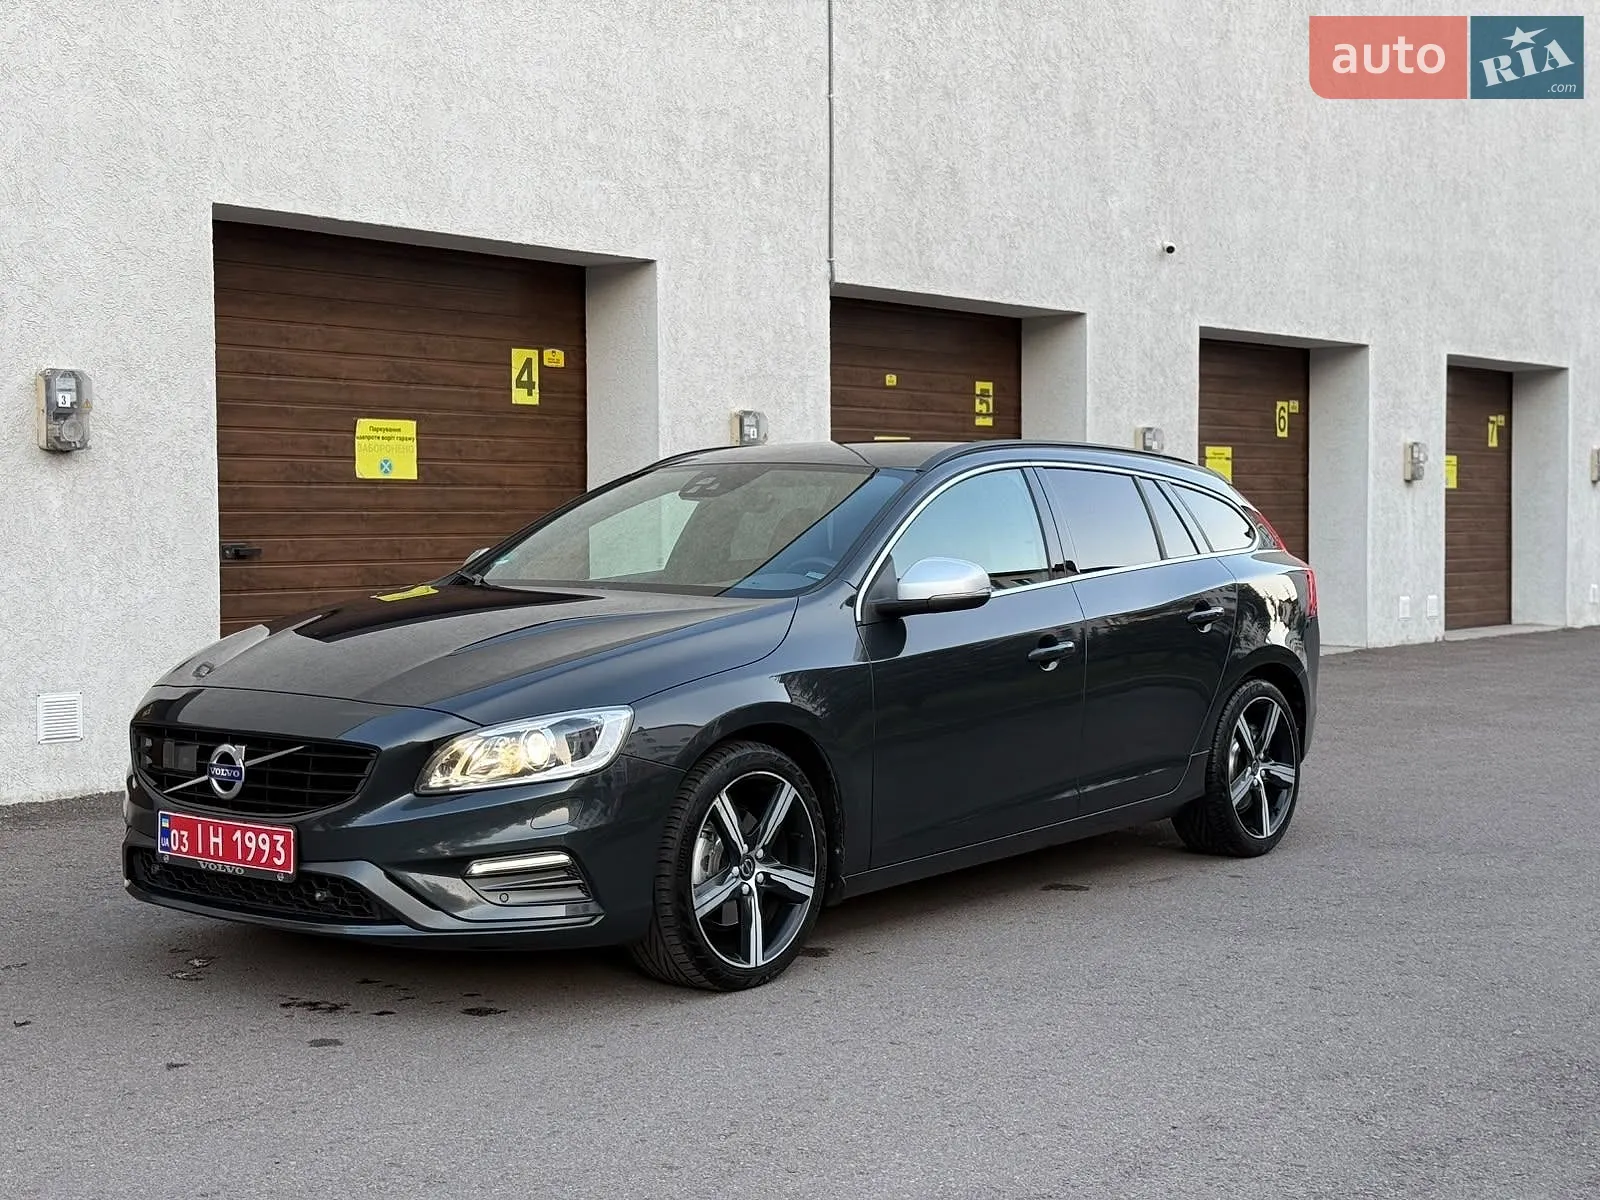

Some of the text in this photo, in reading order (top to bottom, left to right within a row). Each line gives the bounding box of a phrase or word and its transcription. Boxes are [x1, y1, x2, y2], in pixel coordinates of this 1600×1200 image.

[515, 357, 536, 397] 4
[61, 395, 68, 406] 3
[1278, 406, 1287, 432] 6
[210, 767, 241, 778] VOLVO
[161, 837, 170, 847] UA
[170, 829, 189, 853] 03
[232, 829, 286, 866] 1993
[198, 861, 245, 875] VOLVO
